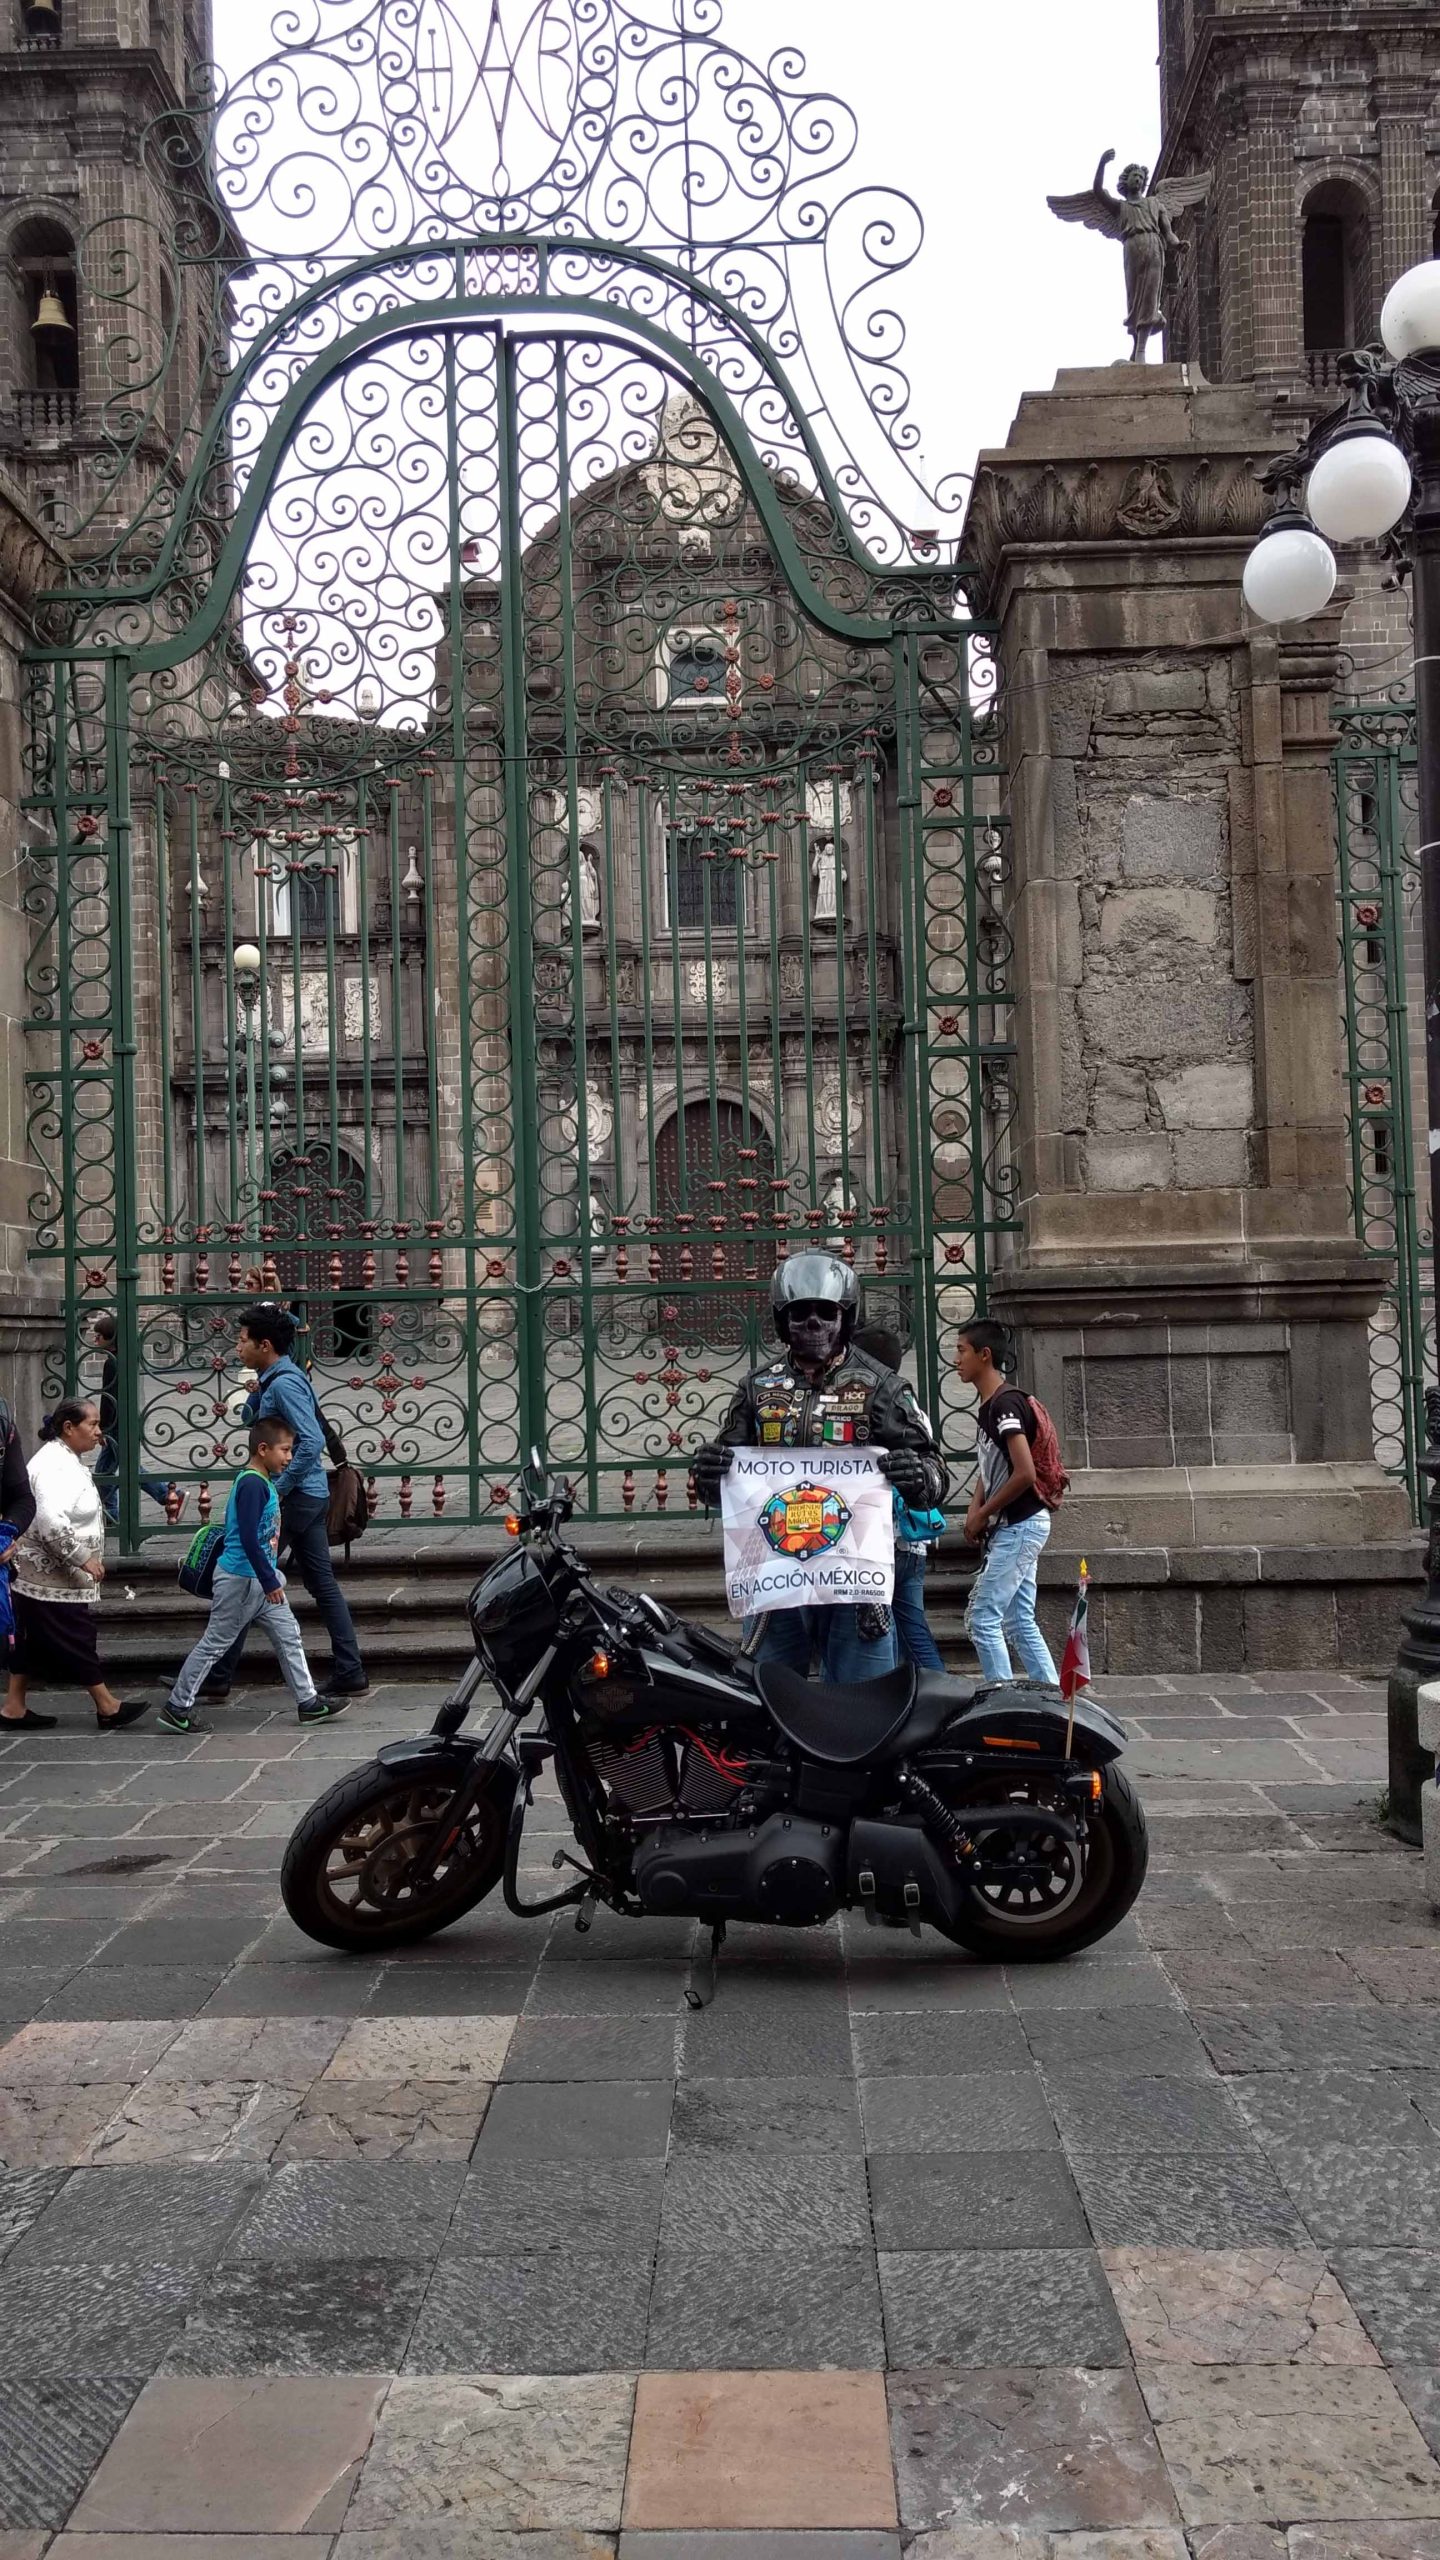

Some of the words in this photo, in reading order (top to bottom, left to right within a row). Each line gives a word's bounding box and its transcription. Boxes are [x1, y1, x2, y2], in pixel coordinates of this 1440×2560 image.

[465, 245, 539, 296] 1893
[844, 1391, 865, 1400] HOG
[737, 1460, 795, 1475] MOTO
[800, 1460, 874, 1475] TURISTA
[731, 1582, 749, 1598] EN
[752, 1569, 815, 1594] ACCIÓN
[819, 1566, 886, 1586] MÉXICO
